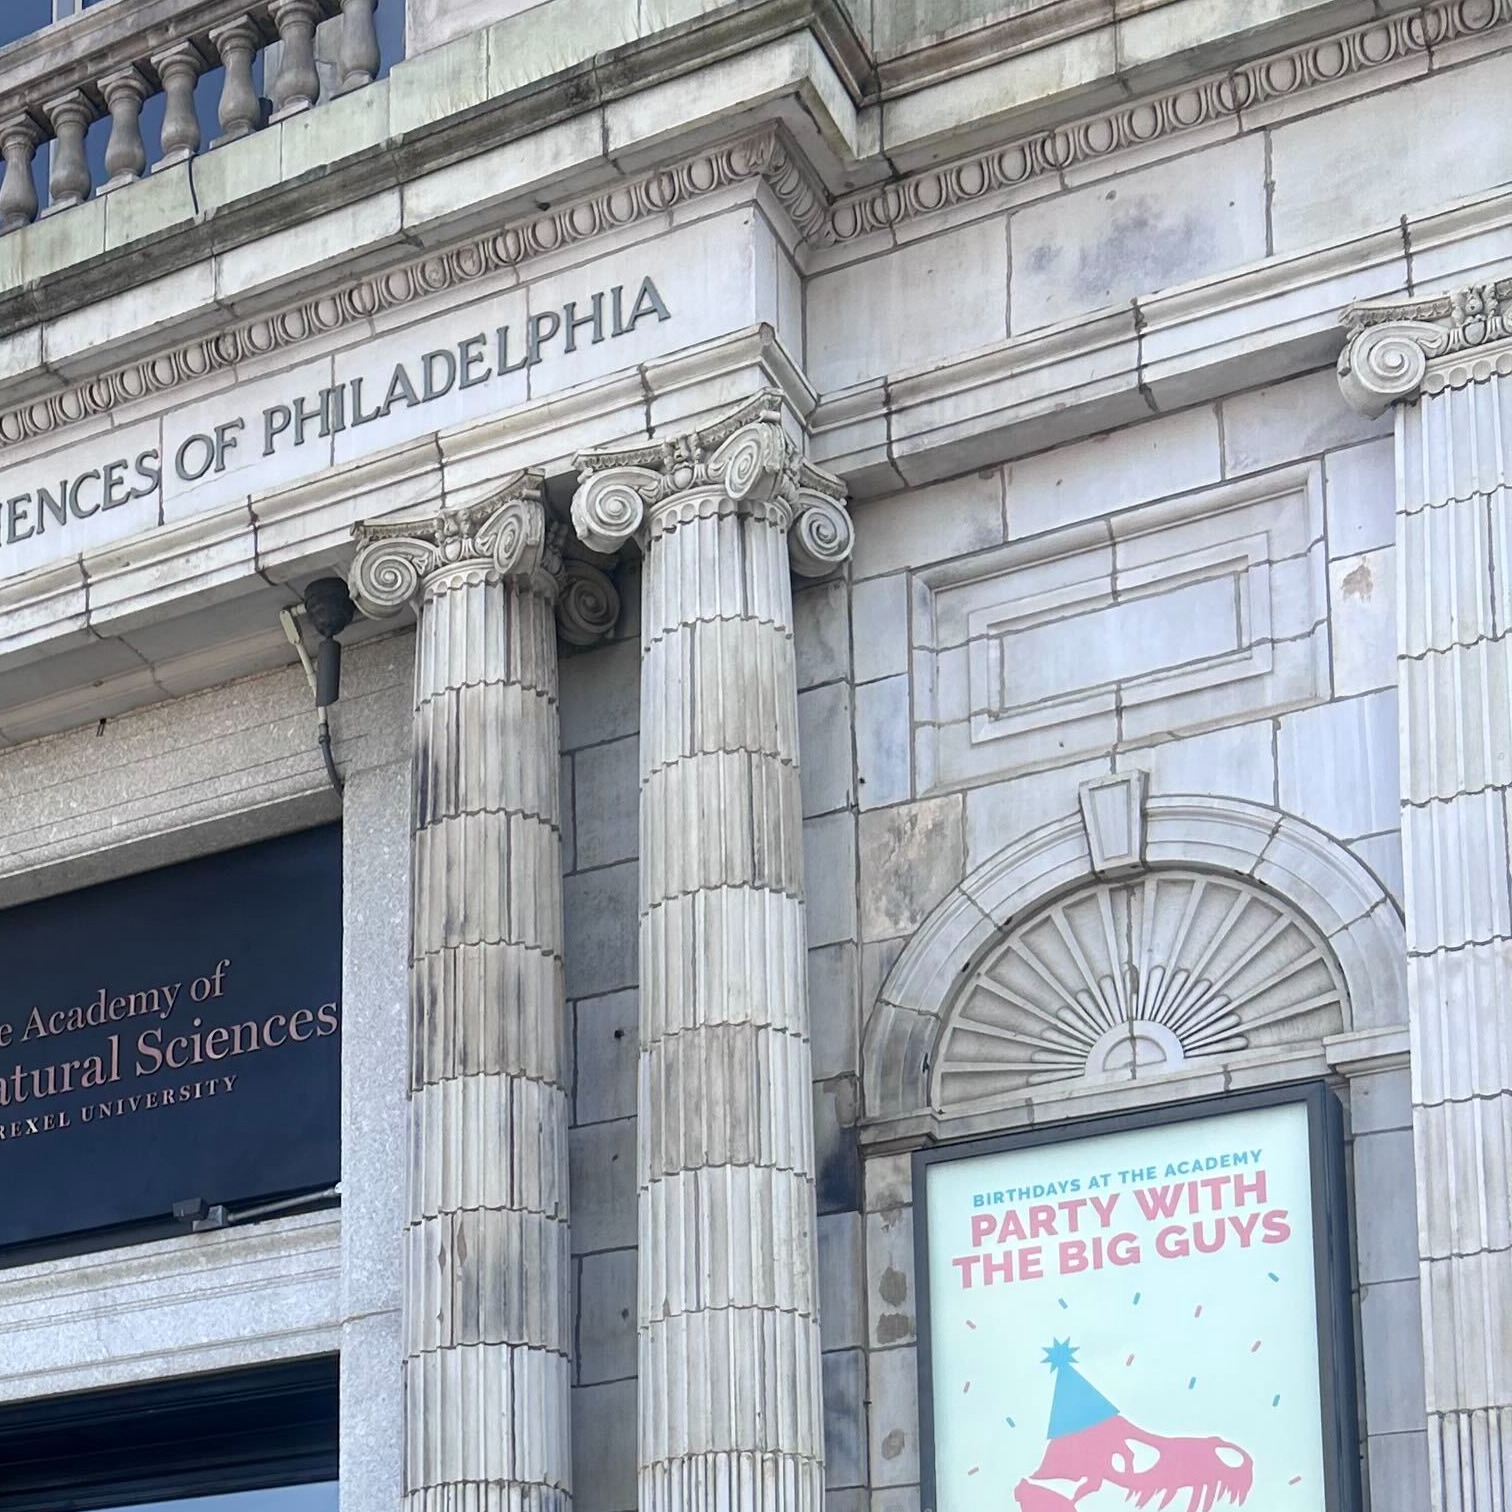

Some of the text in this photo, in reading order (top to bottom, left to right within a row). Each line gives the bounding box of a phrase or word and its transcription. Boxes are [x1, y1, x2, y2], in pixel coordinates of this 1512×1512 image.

[175, 417, 244, 481] OF
[263, 276, 671, 456] PHILADELPHIA
[20, 983, 181, 1041] Academy
[190, 959, 230, 1002] of
[135, 1002, 339, 1077] Sciences
[81, 1074, 239, 1122] UNIVERSITY
[970, 1170, 1268, 1248] PARTY WITH
[972, 1149, 1263, 1208] BIRTHDAYS AT THE ACADEMY
[952, 1209, 1291, 1290] THE BIG GUYS
